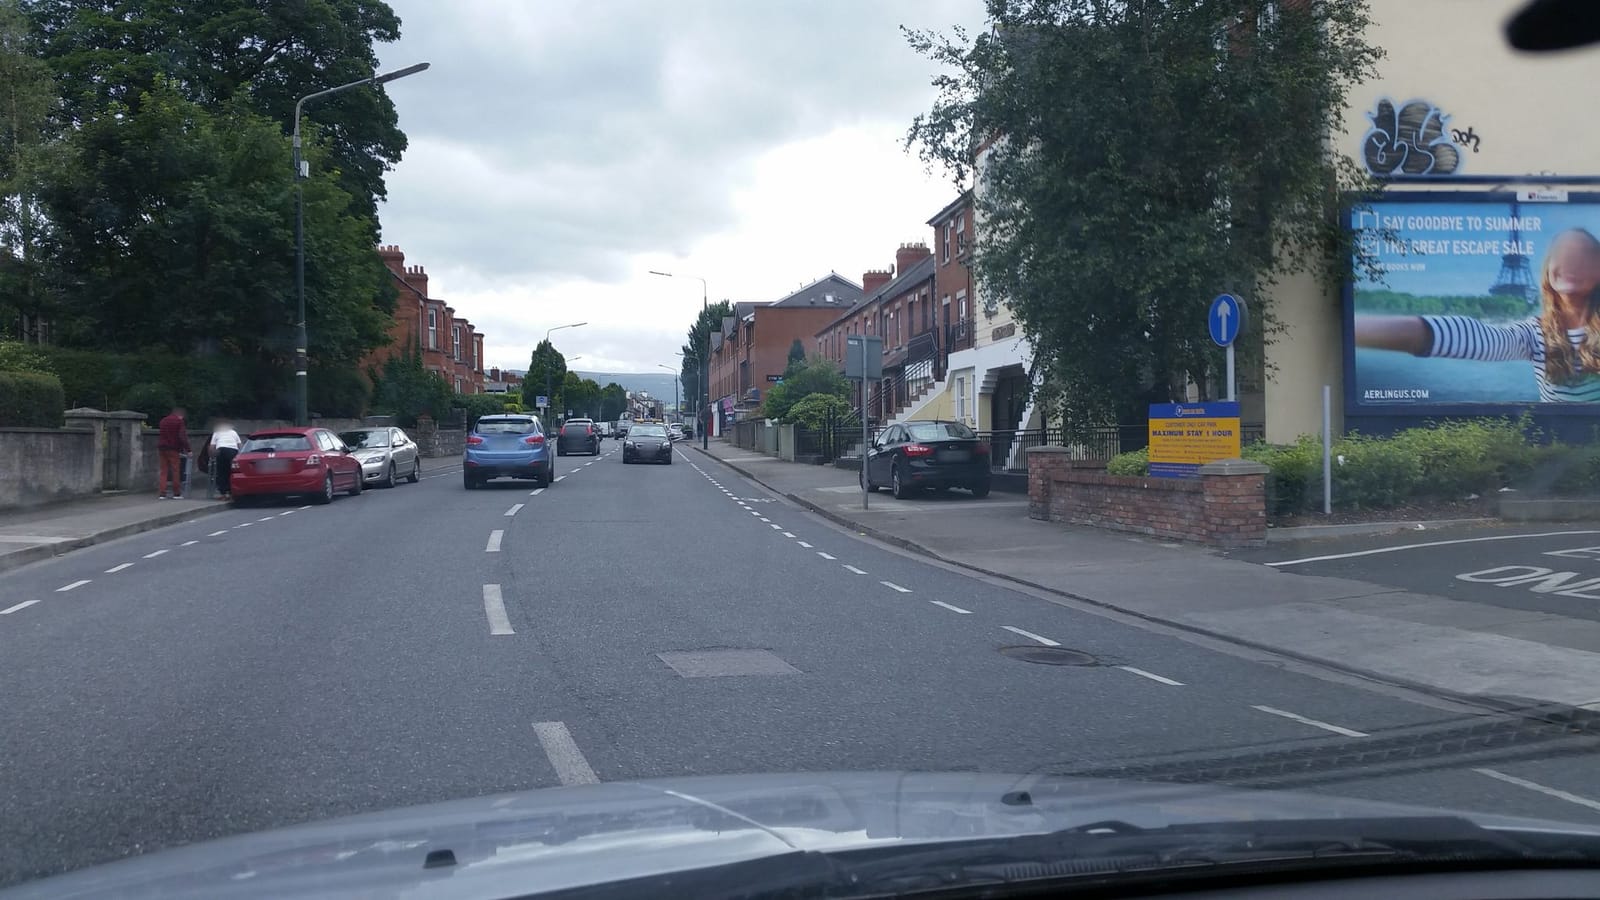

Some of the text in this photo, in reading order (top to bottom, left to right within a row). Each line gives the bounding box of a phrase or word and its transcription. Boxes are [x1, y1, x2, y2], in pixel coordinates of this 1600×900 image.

[1383, 216, 1541, 231] SAY GOODBYE TO SUMMER
[1384, 240, 1534, 255] THE GREAT ESCAPE SALE
[1364, 389, 1429, 399] AERLINGUS.COM
